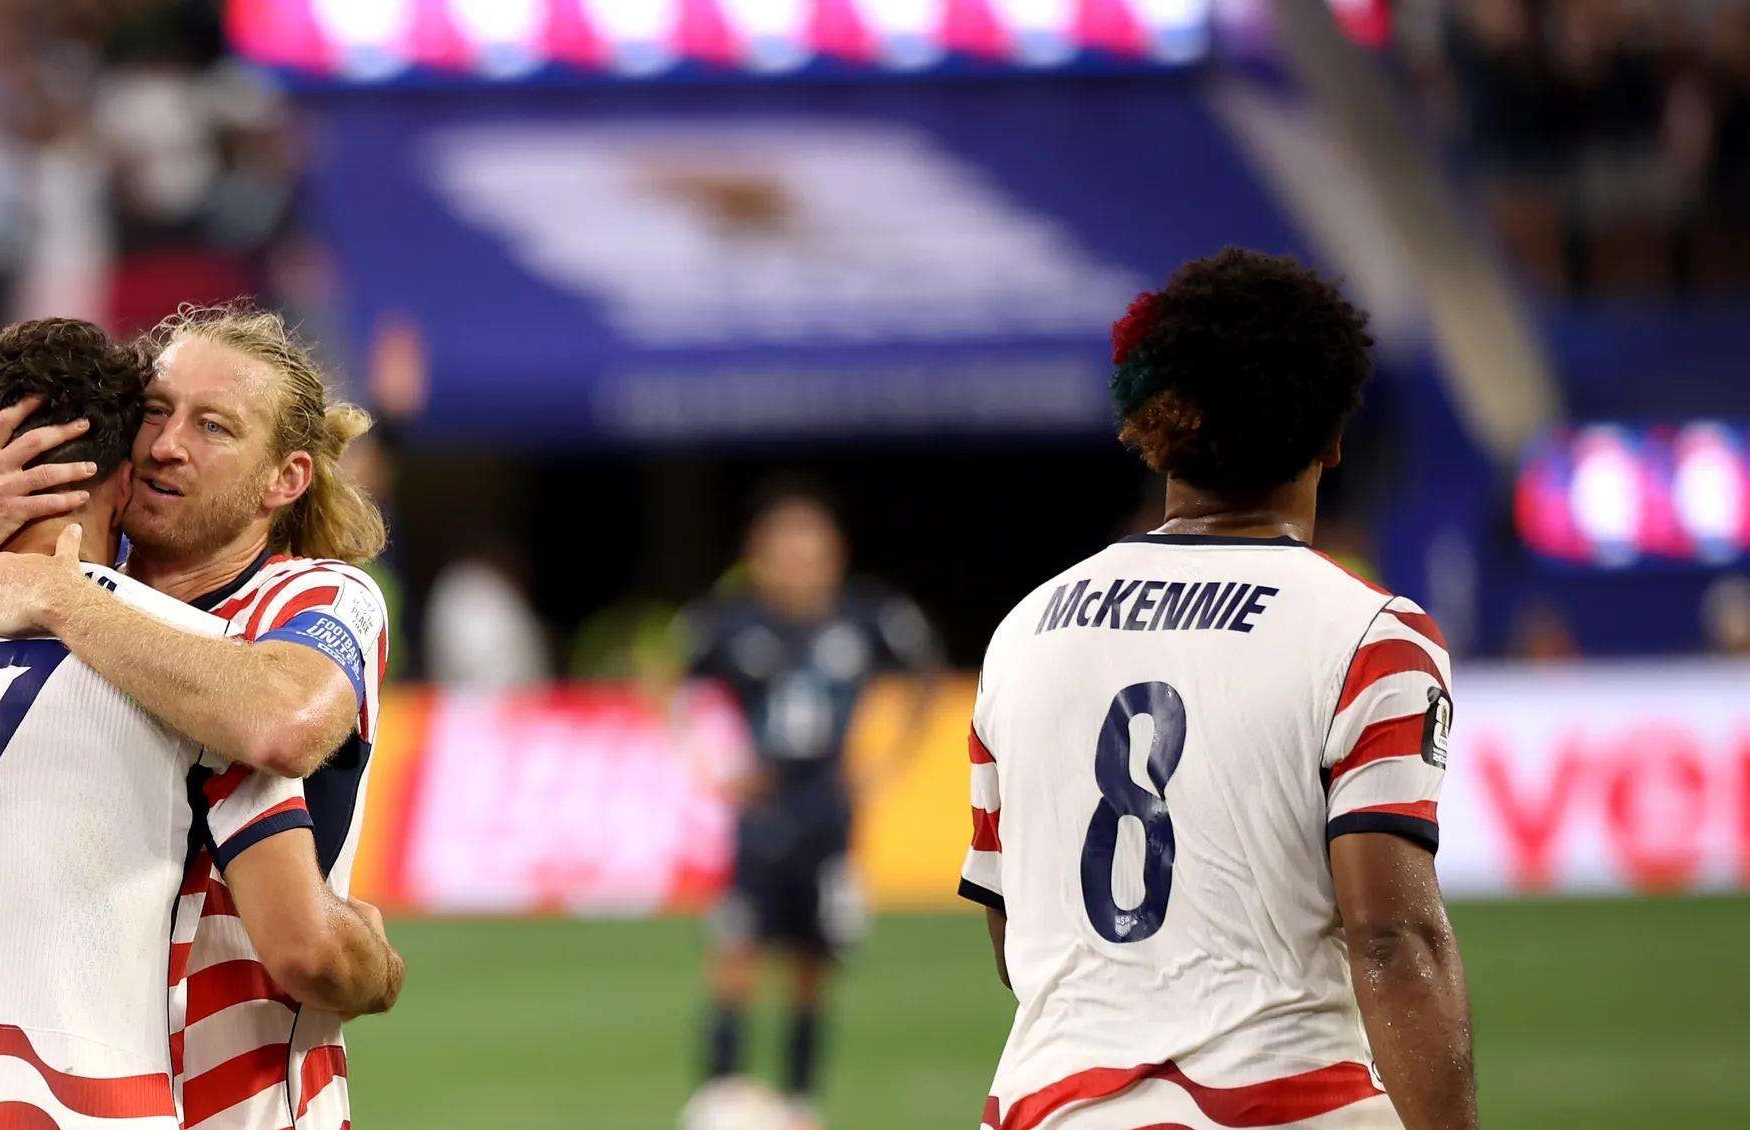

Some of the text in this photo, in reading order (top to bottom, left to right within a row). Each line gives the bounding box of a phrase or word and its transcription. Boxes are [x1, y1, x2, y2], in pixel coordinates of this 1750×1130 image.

[1034, 578, 1280, 636] McKENNIE
[1081, 681, 1187, 944] 8
[1472, 730, 1750, 893] ve
